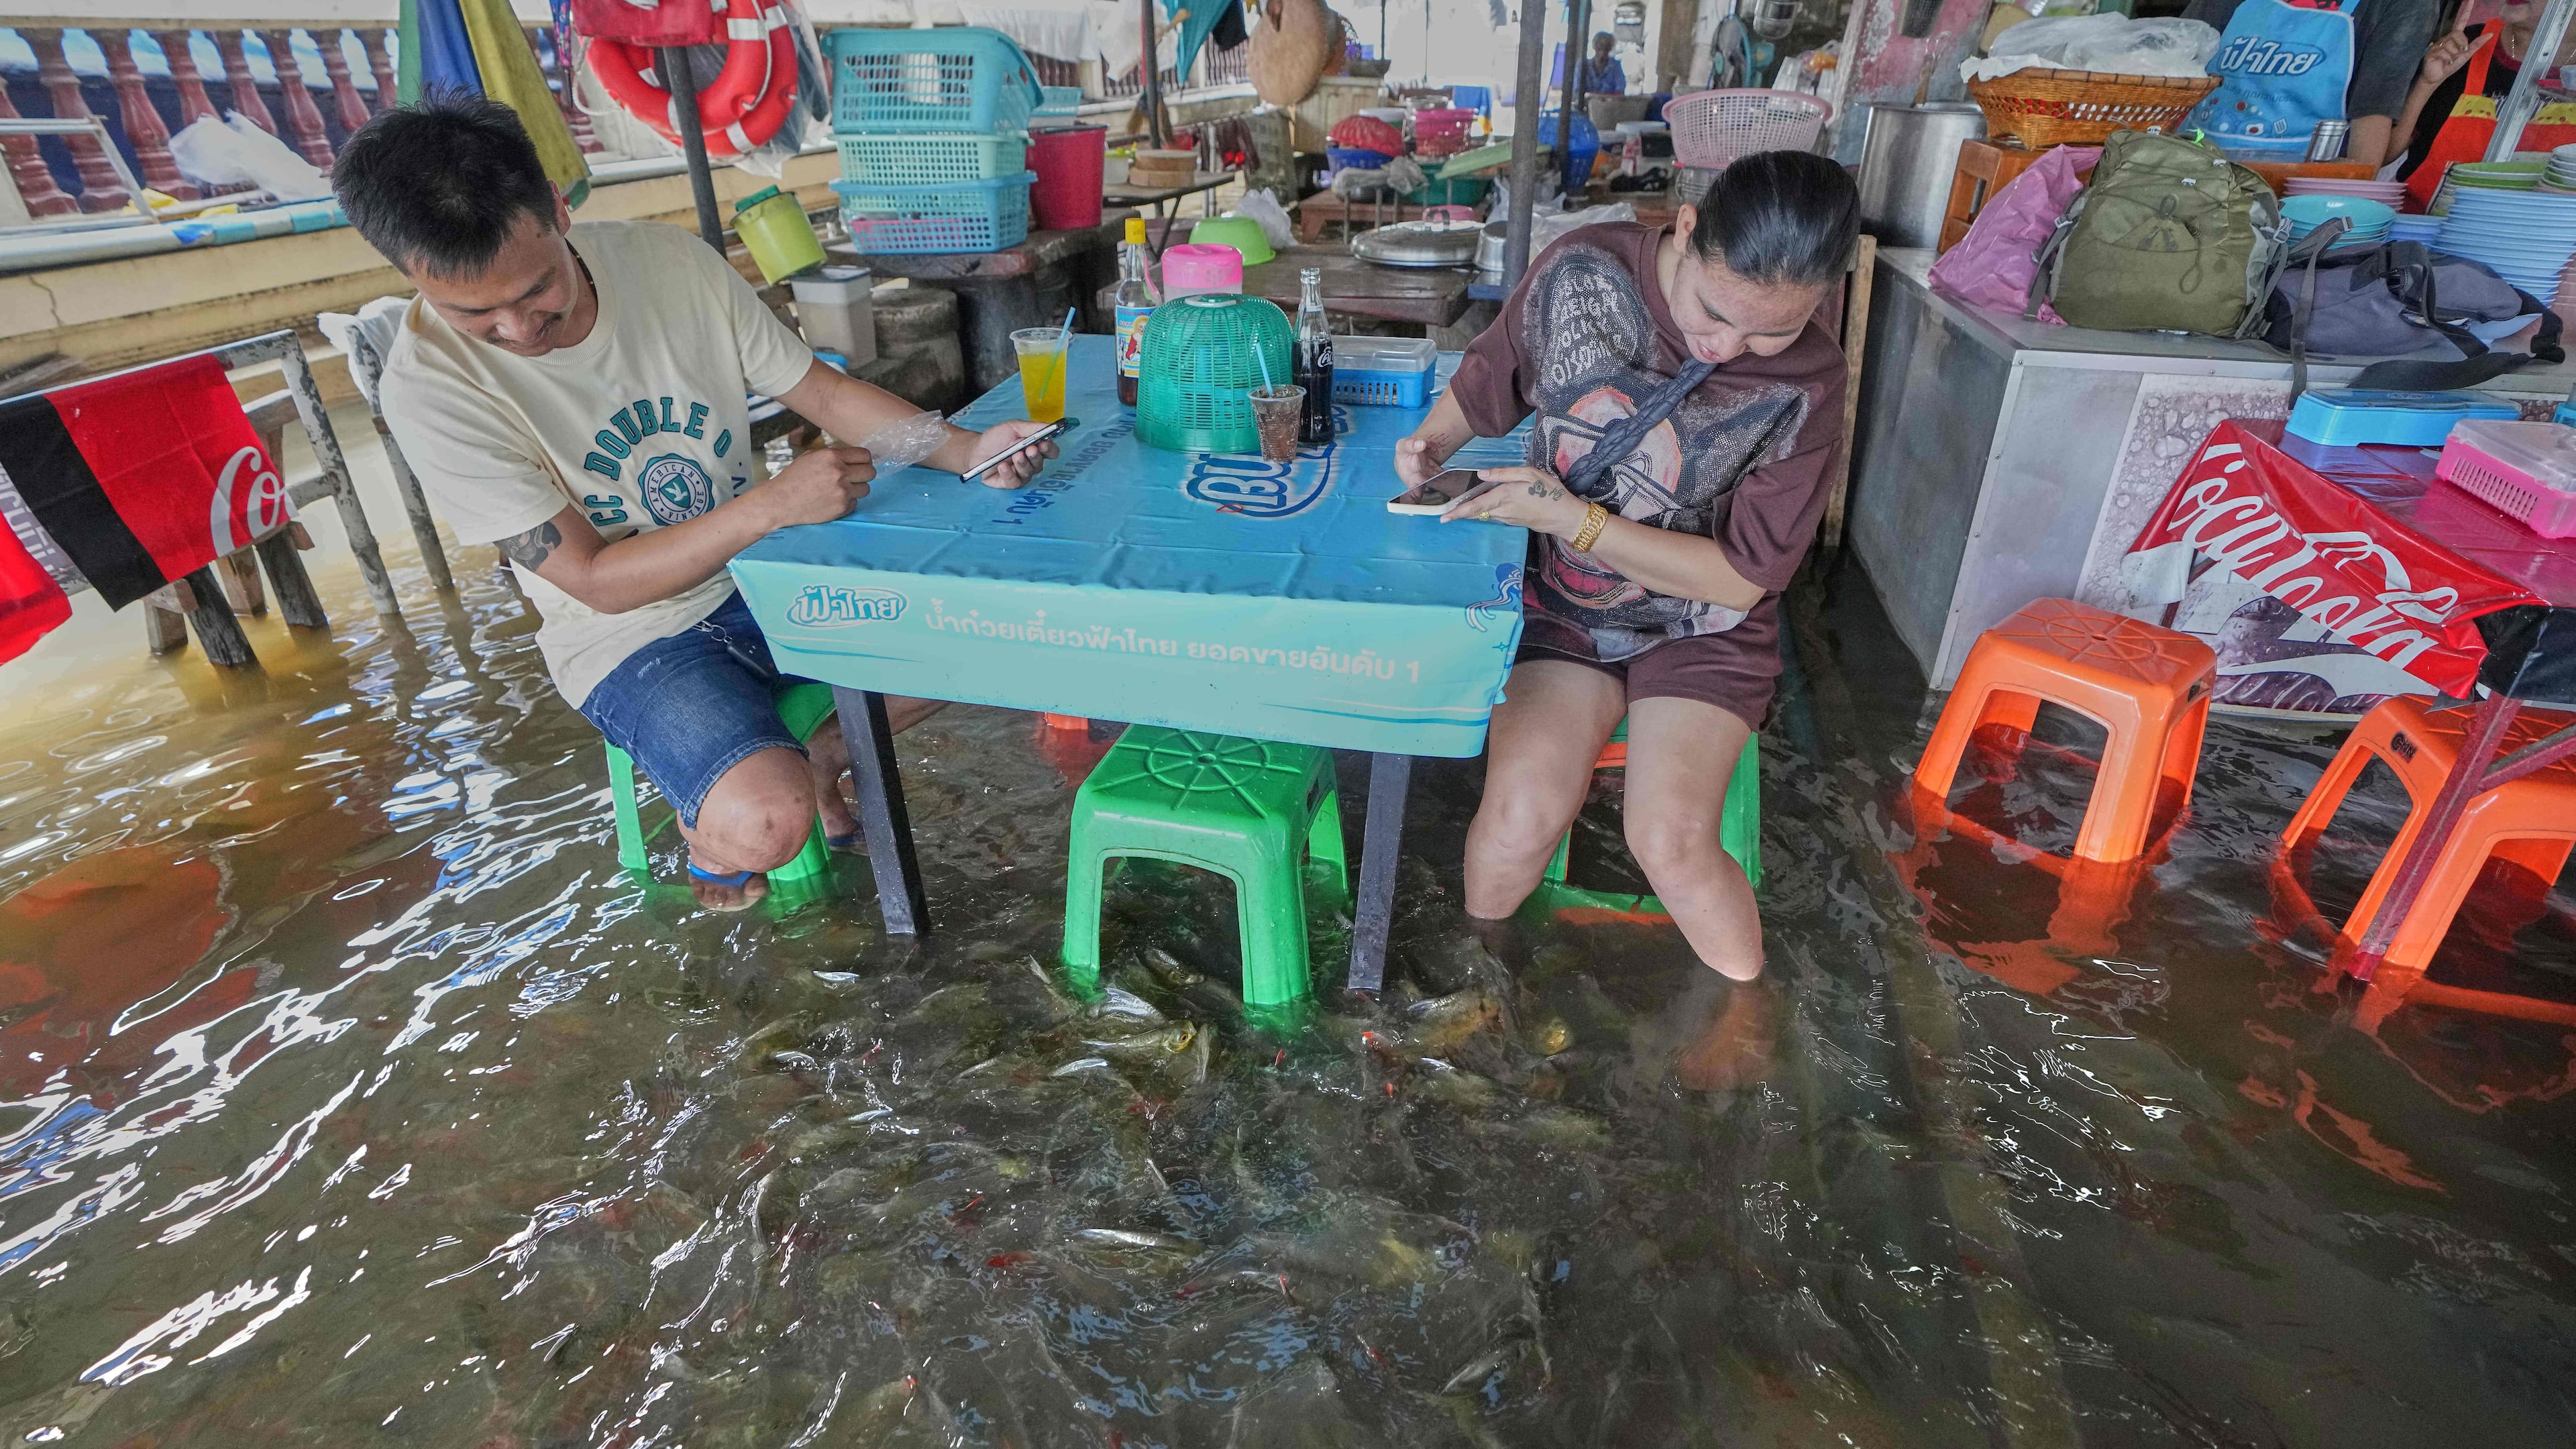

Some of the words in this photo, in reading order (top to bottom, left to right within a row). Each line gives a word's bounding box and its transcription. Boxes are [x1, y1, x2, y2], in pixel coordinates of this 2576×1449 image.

[2219, 35, 2320, 75] ฟ้าไทย
[584, 397, 709, 480] DOUBLE
[651, 465, 695, 502] AMERICAN
[669, 491, 704, 521] VINTAGE
[791, 585, 904, 624] ฟ้าไทย
[925, 597, 1177, 655] น้ำก๋วยเตี๋ยวฟ้าไทย
[1189, 642, 1395, 680] ยอดขายอันดับ
[1407, 661, 1419, 683] 1
